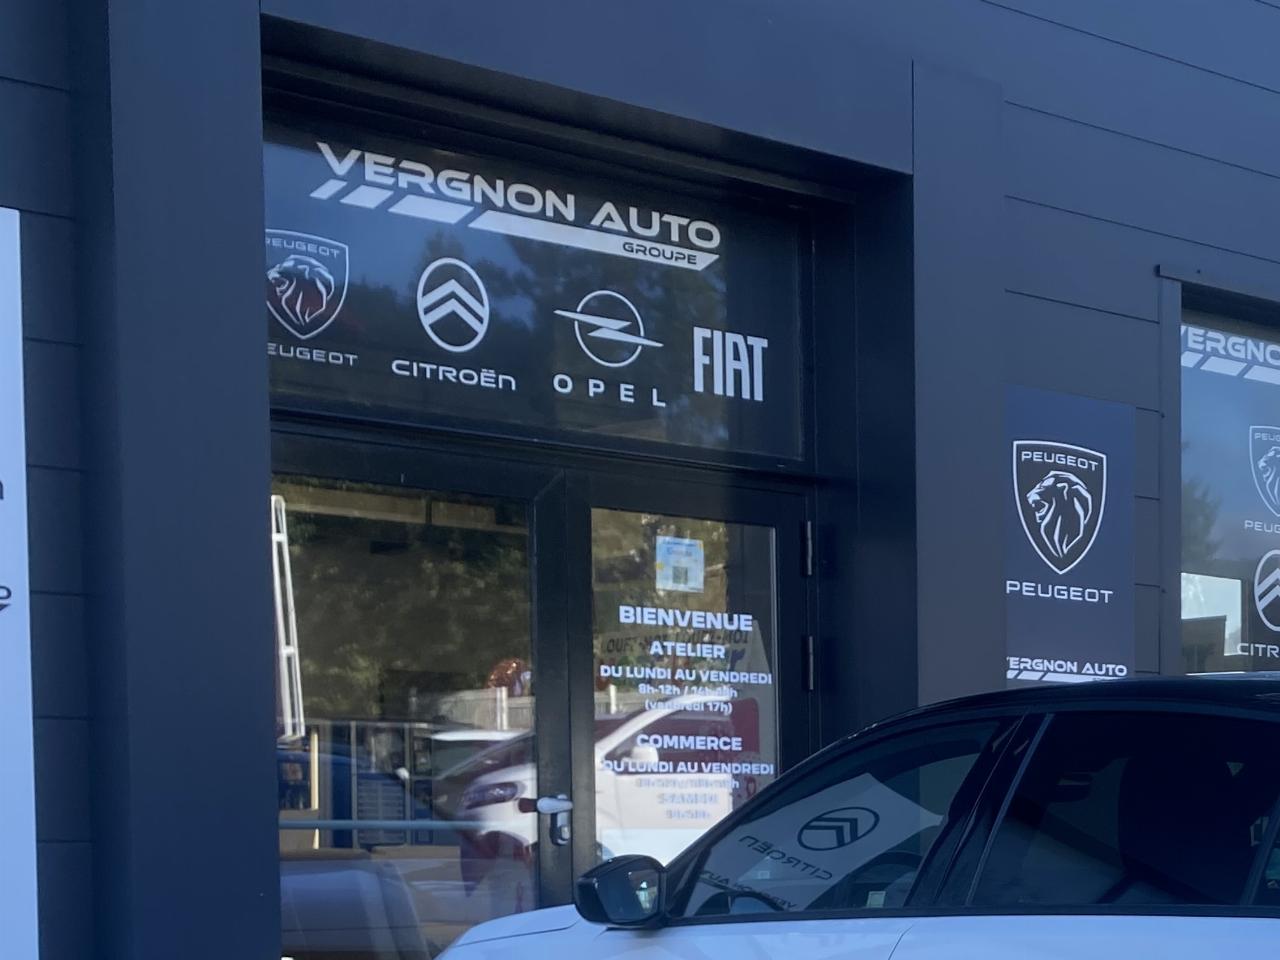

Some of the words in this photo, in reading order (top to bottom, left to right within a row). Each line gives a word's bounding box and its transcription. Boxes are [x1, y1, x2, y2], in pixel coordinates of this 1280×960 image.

[315, 142, 575, 221] VERGNON
[590, 201, 721, 249] AUTO
[622, 242, 698, 265] GROUPE
[267, 343, 358, 367] EUGEOT
[693, 326, 768, 401] FIAT
[553, 373, 666, 408] OPEL
[1021, 451, 1099, 471] PEUGEOT
[1006, 580, 1114, 604] PEUGEOT
[619, 604, 753, 631] BIENVENUE
[649, 640, 726, 659] ATELIER
[600, 664, 623, 678] DU
[625, 665, 671, 680] LUNDI
[674, 668, 697, 682] AU
[699, 670, 773, 685] VENDREDI
[1006, 656, 1078, 673] ERGNON
[1081, 662, 1128, 677] AUTO
[636, 733, 743, 752] COMMERCE
[627, 760, 674, 774] LUNDI
[676, 761, 699, 774] AU
[699, 762, 774, 776] VENDREDI
